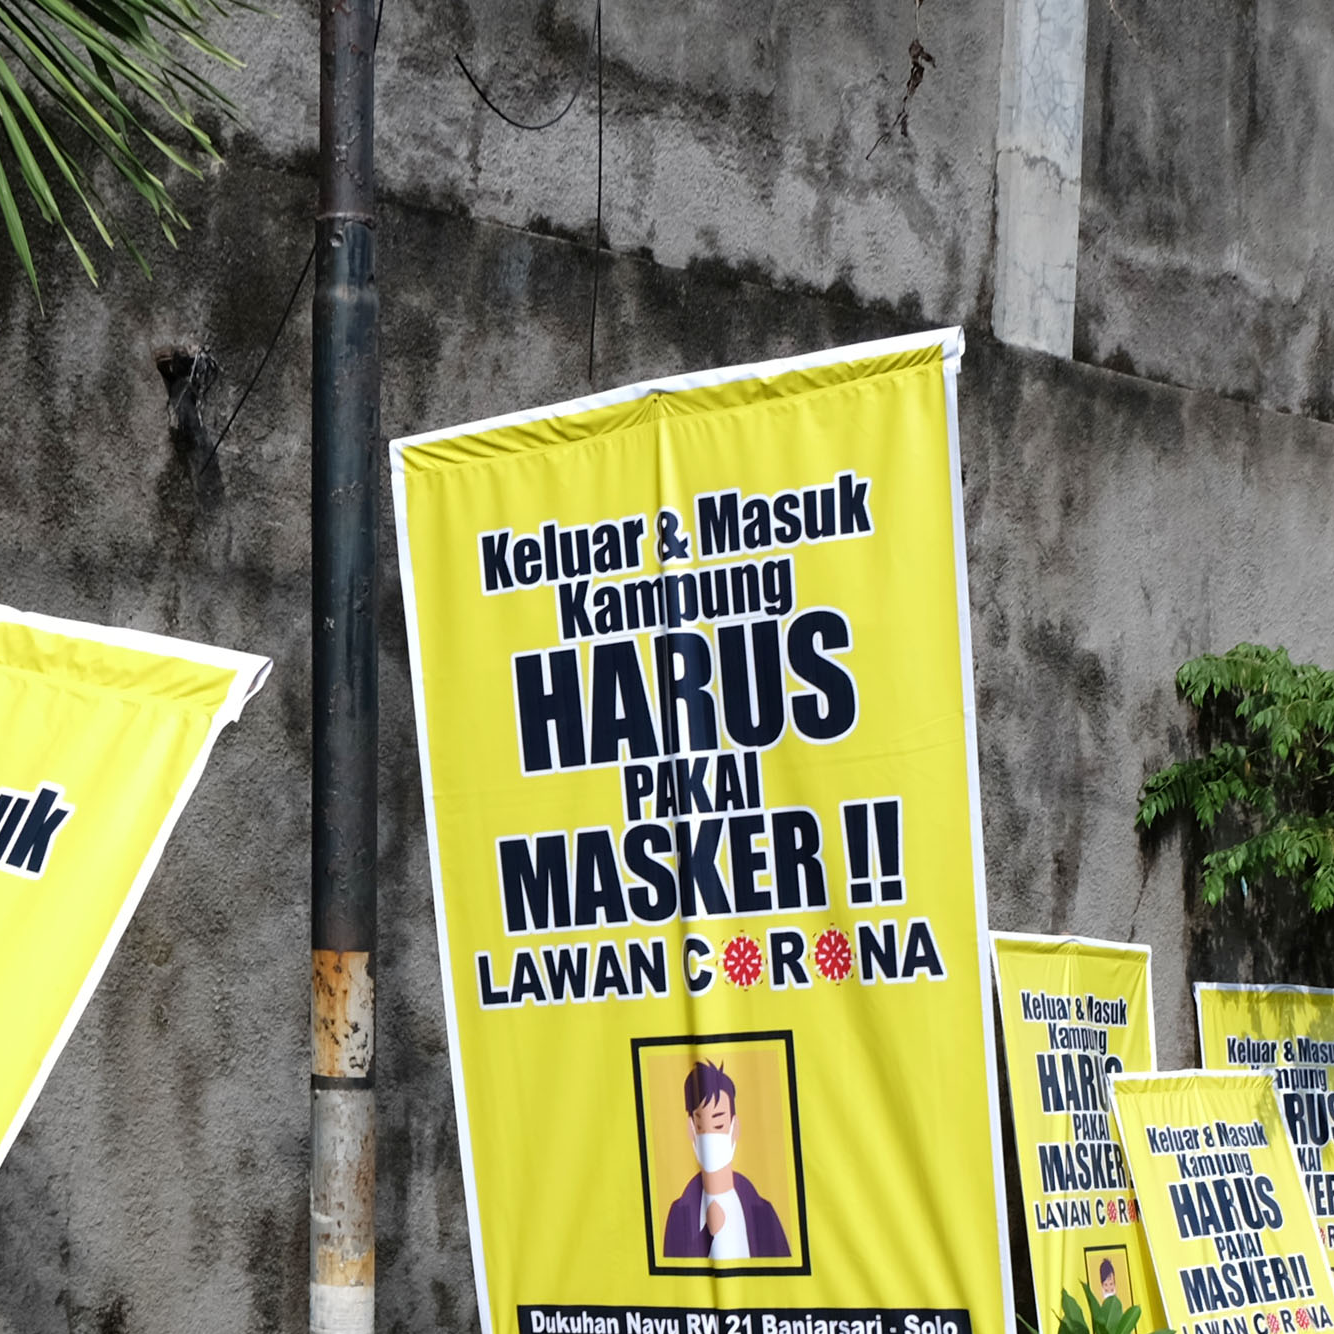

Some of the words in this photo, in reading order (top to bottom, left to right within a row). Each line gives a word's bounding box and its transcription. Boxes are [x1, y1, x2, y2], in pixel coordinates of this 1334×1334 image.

[481, 517, 643, 591] Keluar
[657, 510, 690, 561] &
[698, 474, 870, 556] Masuk
[558, 558, 793, 640] Kampung
[515, 611, 856, 772] HARUS
[624, 752, 761, 821] PAKAI
[499, 811, 827, 932] MASKER
[843, 800, 903, 904] !!
[478, 941, 666, 1005] LAWAN
[1021, 992, 1071, 1020] Keluar
[1075, 998, 1084, 1020] &
[1048, 1022, 1107, 1055] Kampung
[1227, 1037, 1277, 1063] Keluar
[1284, 1041, 1295, 1062] &
[1073, 1113, 1110, 1141] PAKAI
[1146, 1126, 1200, 1154] Keluar
[1215, 1121, 1269, 1147] Masuk
[1038, 1143, 1127, 1193] MASKER
[1035, 1199, 1091, 1230] LAWAN
[1169, 1175, 1283, 1239] HARUS
[1214, 1231, 1264, 1262] PAKAI
